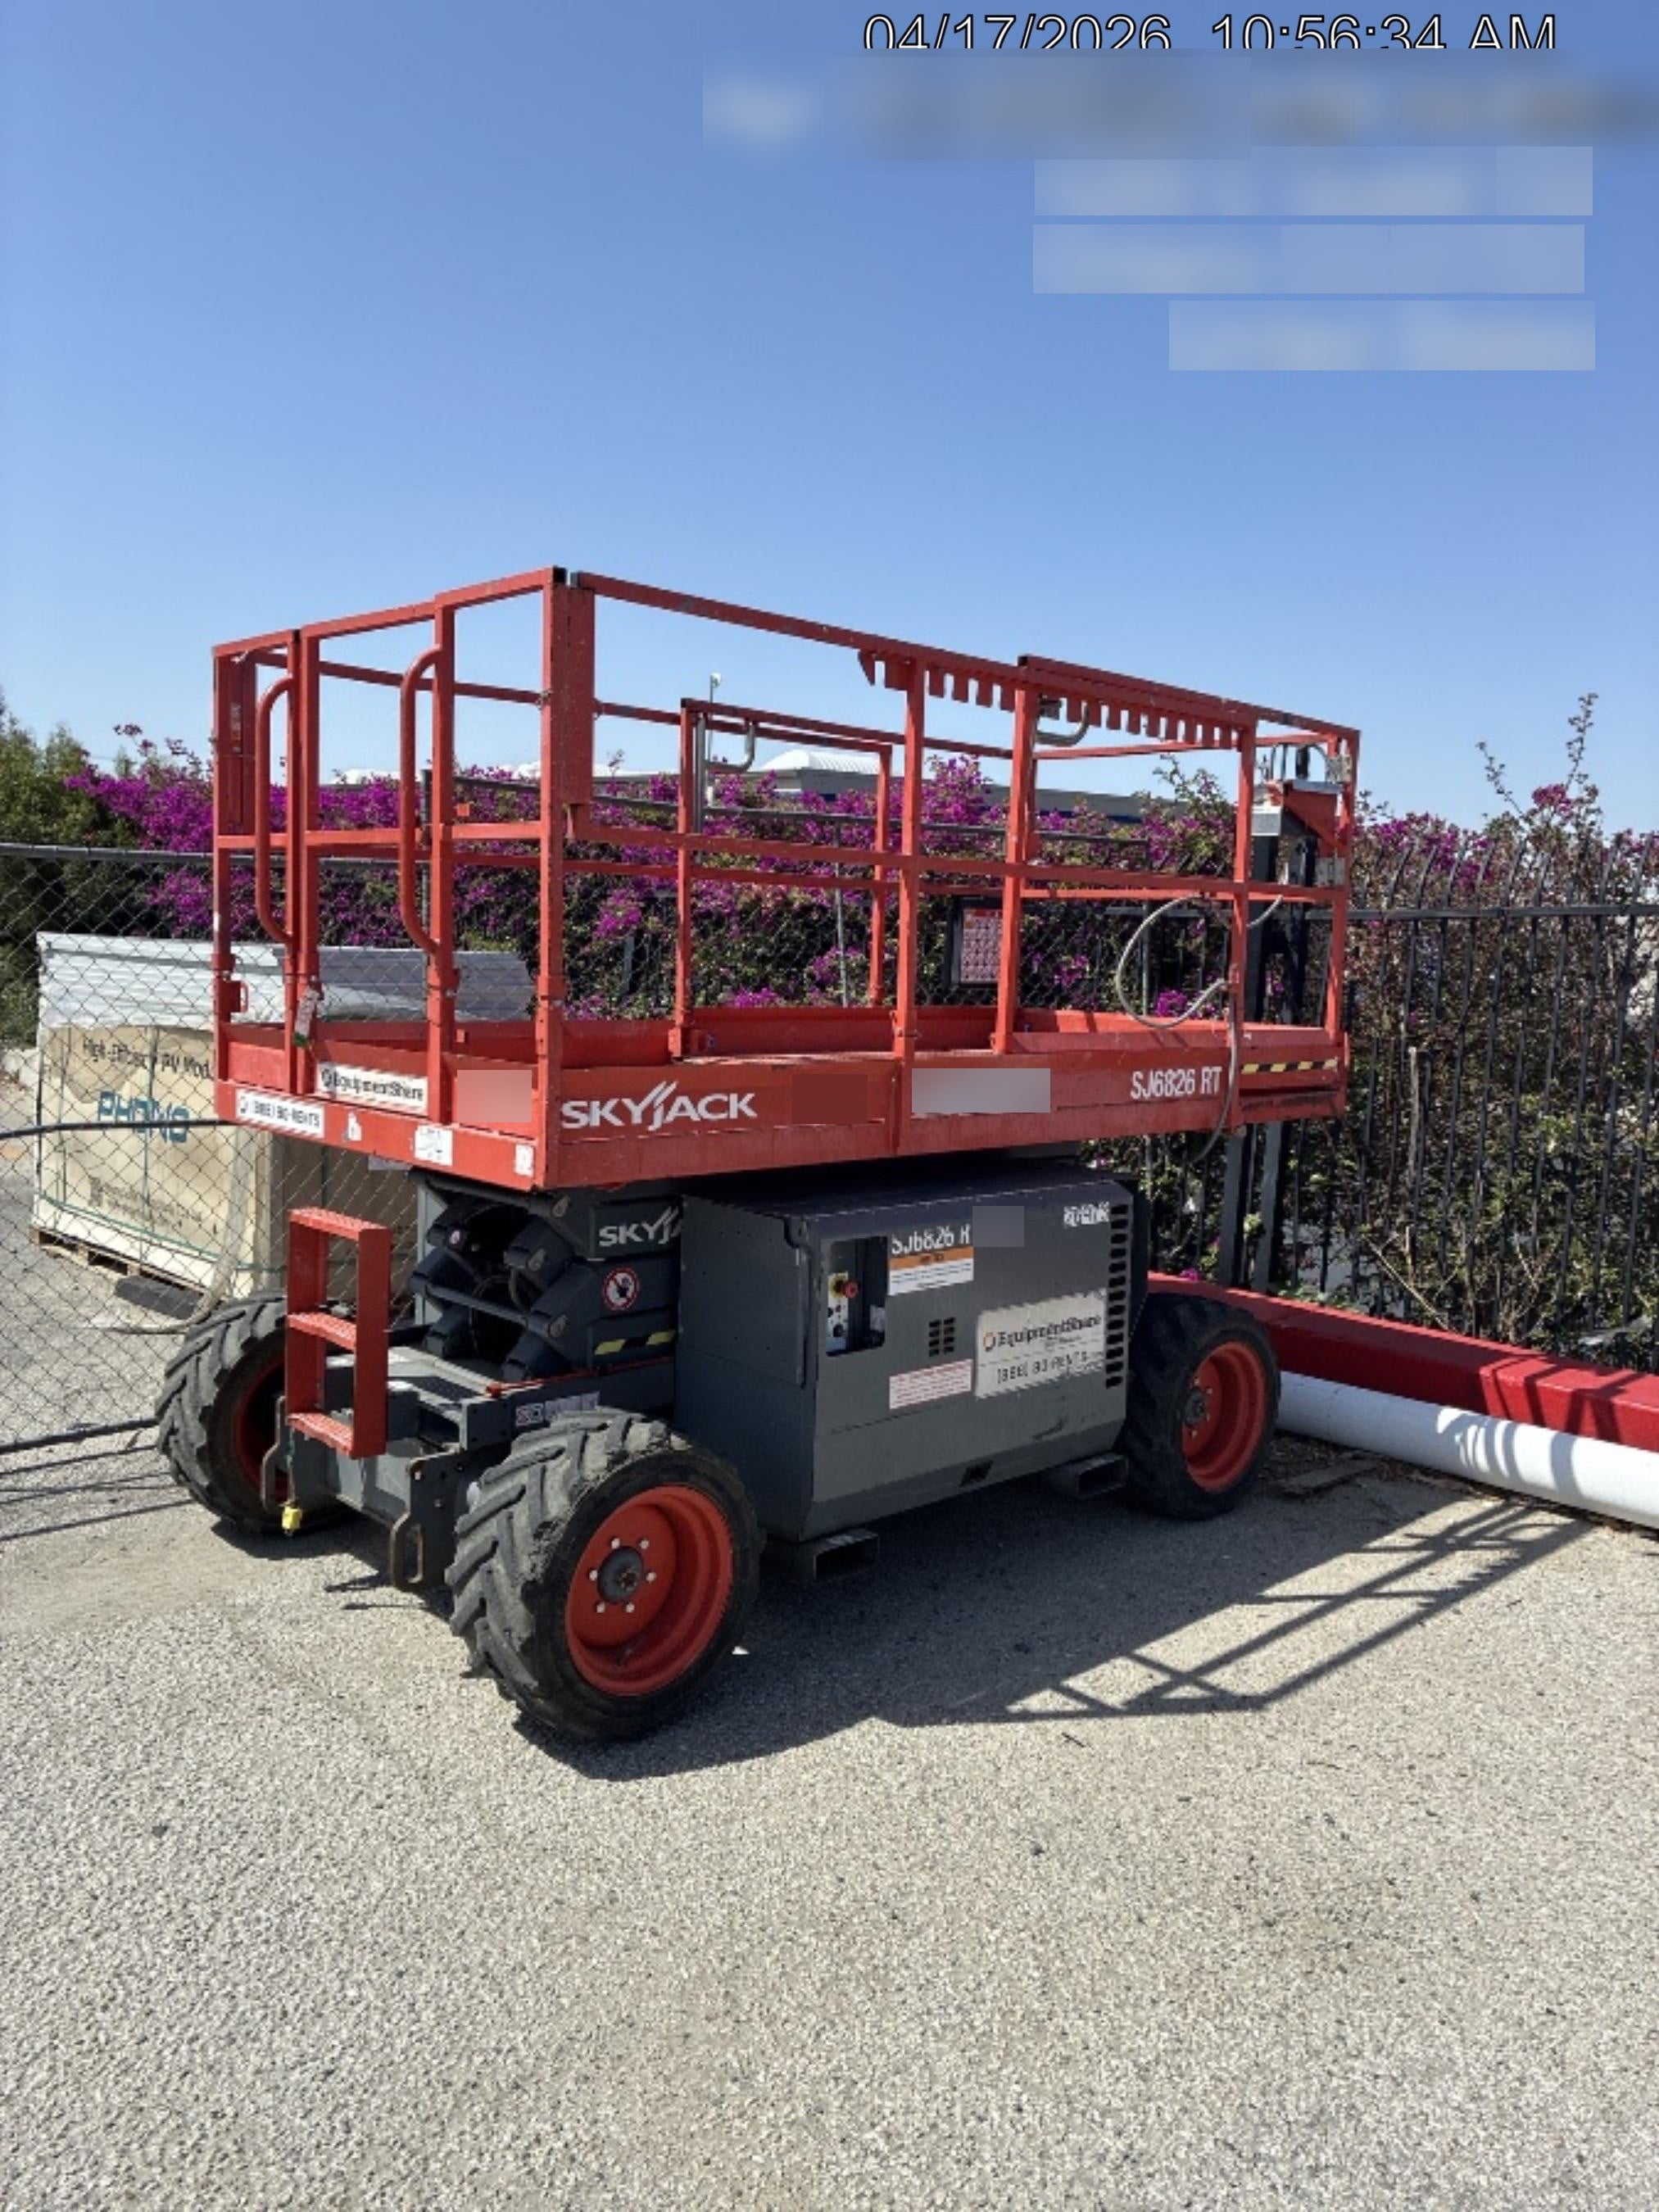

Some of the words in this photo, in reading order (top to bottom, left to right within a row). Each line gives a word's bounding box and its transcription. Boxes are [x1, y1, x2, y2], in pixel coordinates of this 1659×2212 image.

[1131, 1068, 1196, 1099] SJ6826
[1200, 1066, 1222, 1095] RT
[561, 1081, 757, 1131] SKYJACK
[599, 1206, 682, 1246] SKYJ
